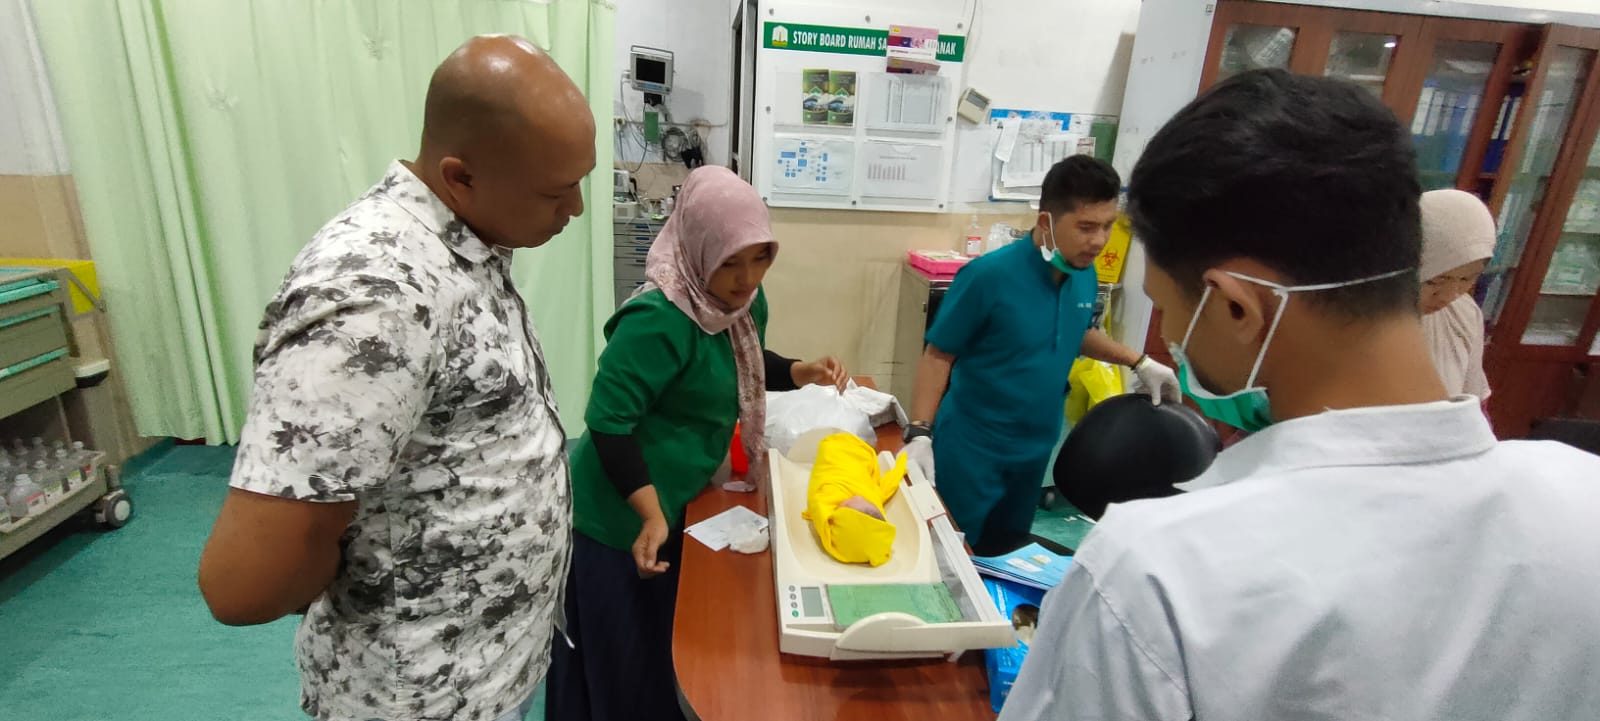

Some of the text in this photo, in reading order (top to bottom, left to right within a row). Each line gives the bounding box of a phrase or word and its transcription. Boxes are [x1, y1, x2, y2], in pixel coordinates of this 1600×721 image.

[793, 31, 818, 45] STORY
[819, 33, 846, 47] BOARD
[848, 35, 876, 50] RUMAH
[878, 37, 887, 50] SA
